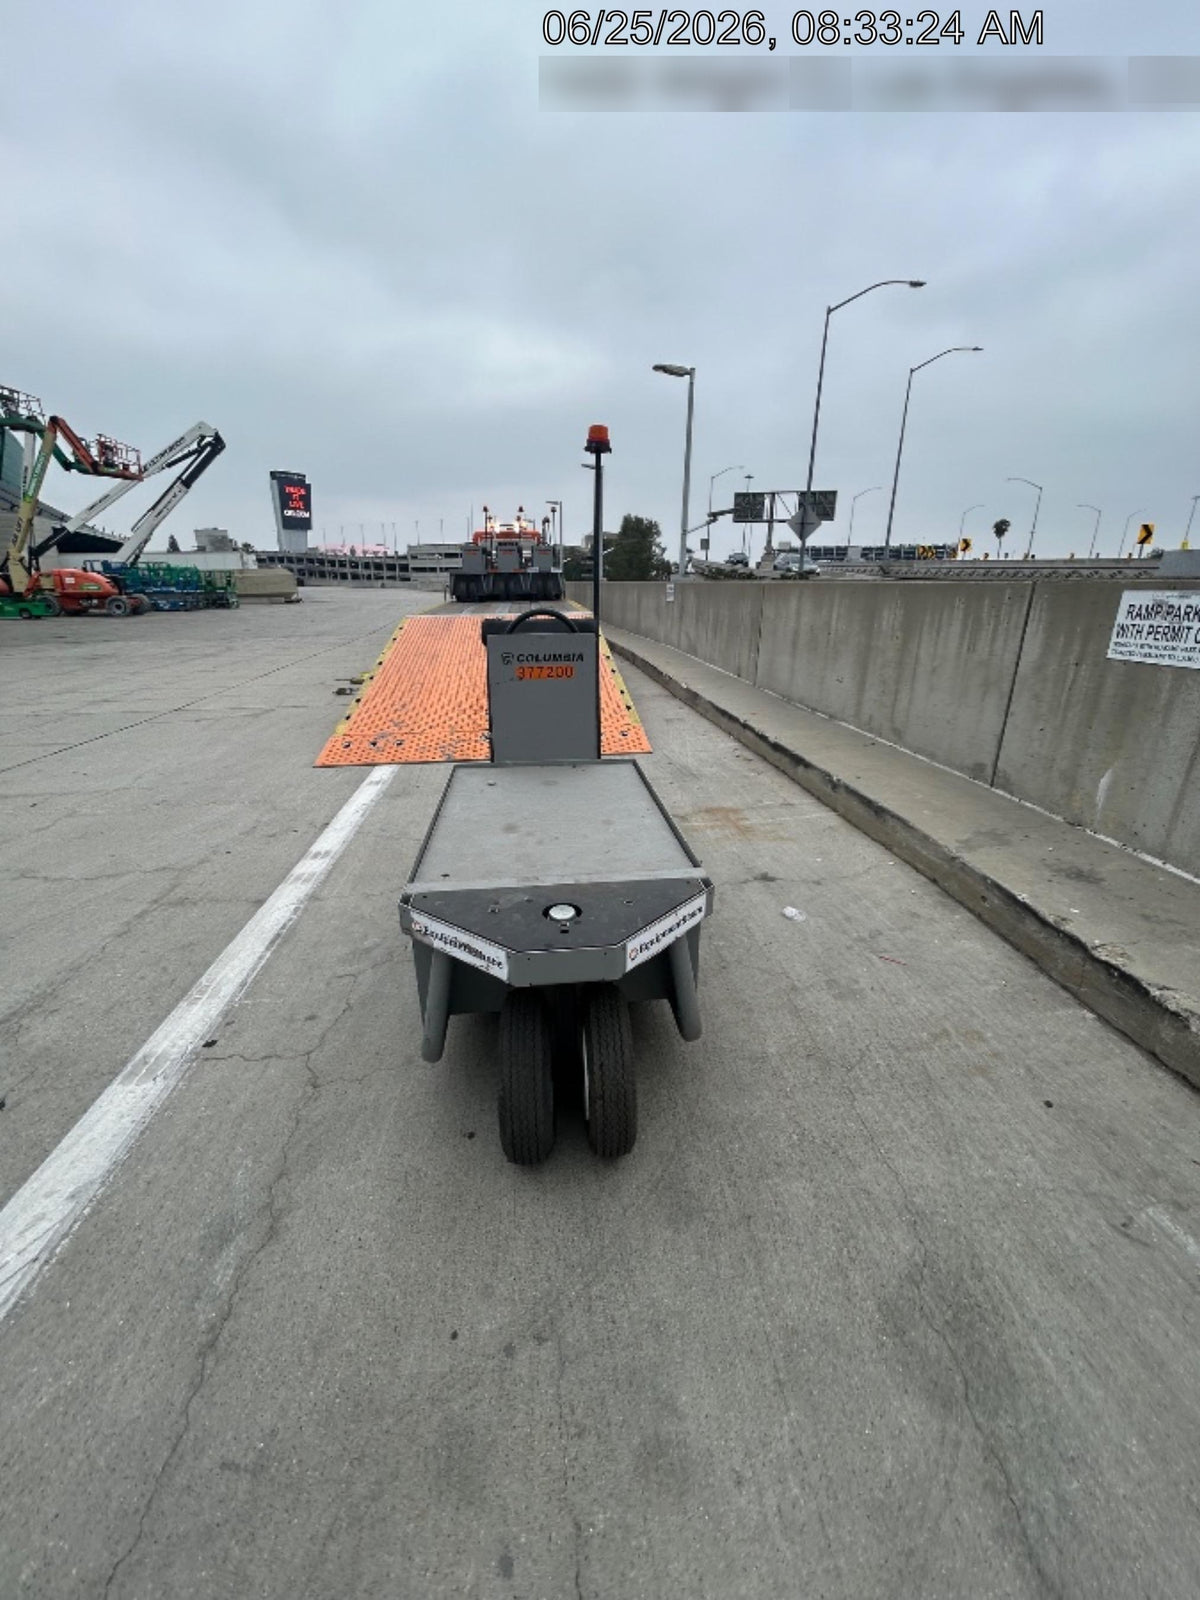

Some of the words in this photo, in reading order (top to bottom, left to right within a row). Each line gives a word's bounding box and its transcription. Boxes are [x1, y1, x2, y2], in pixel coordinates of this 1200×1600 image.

[1125, 604, 1163, 621] RAMP
[1116, 623, 1145, 641] WITH
[1145, 625, 1193, 644] PERMIT
[516, 653, 584, 663] COLUMBIA
[517, 666, 574, 680] 377200
